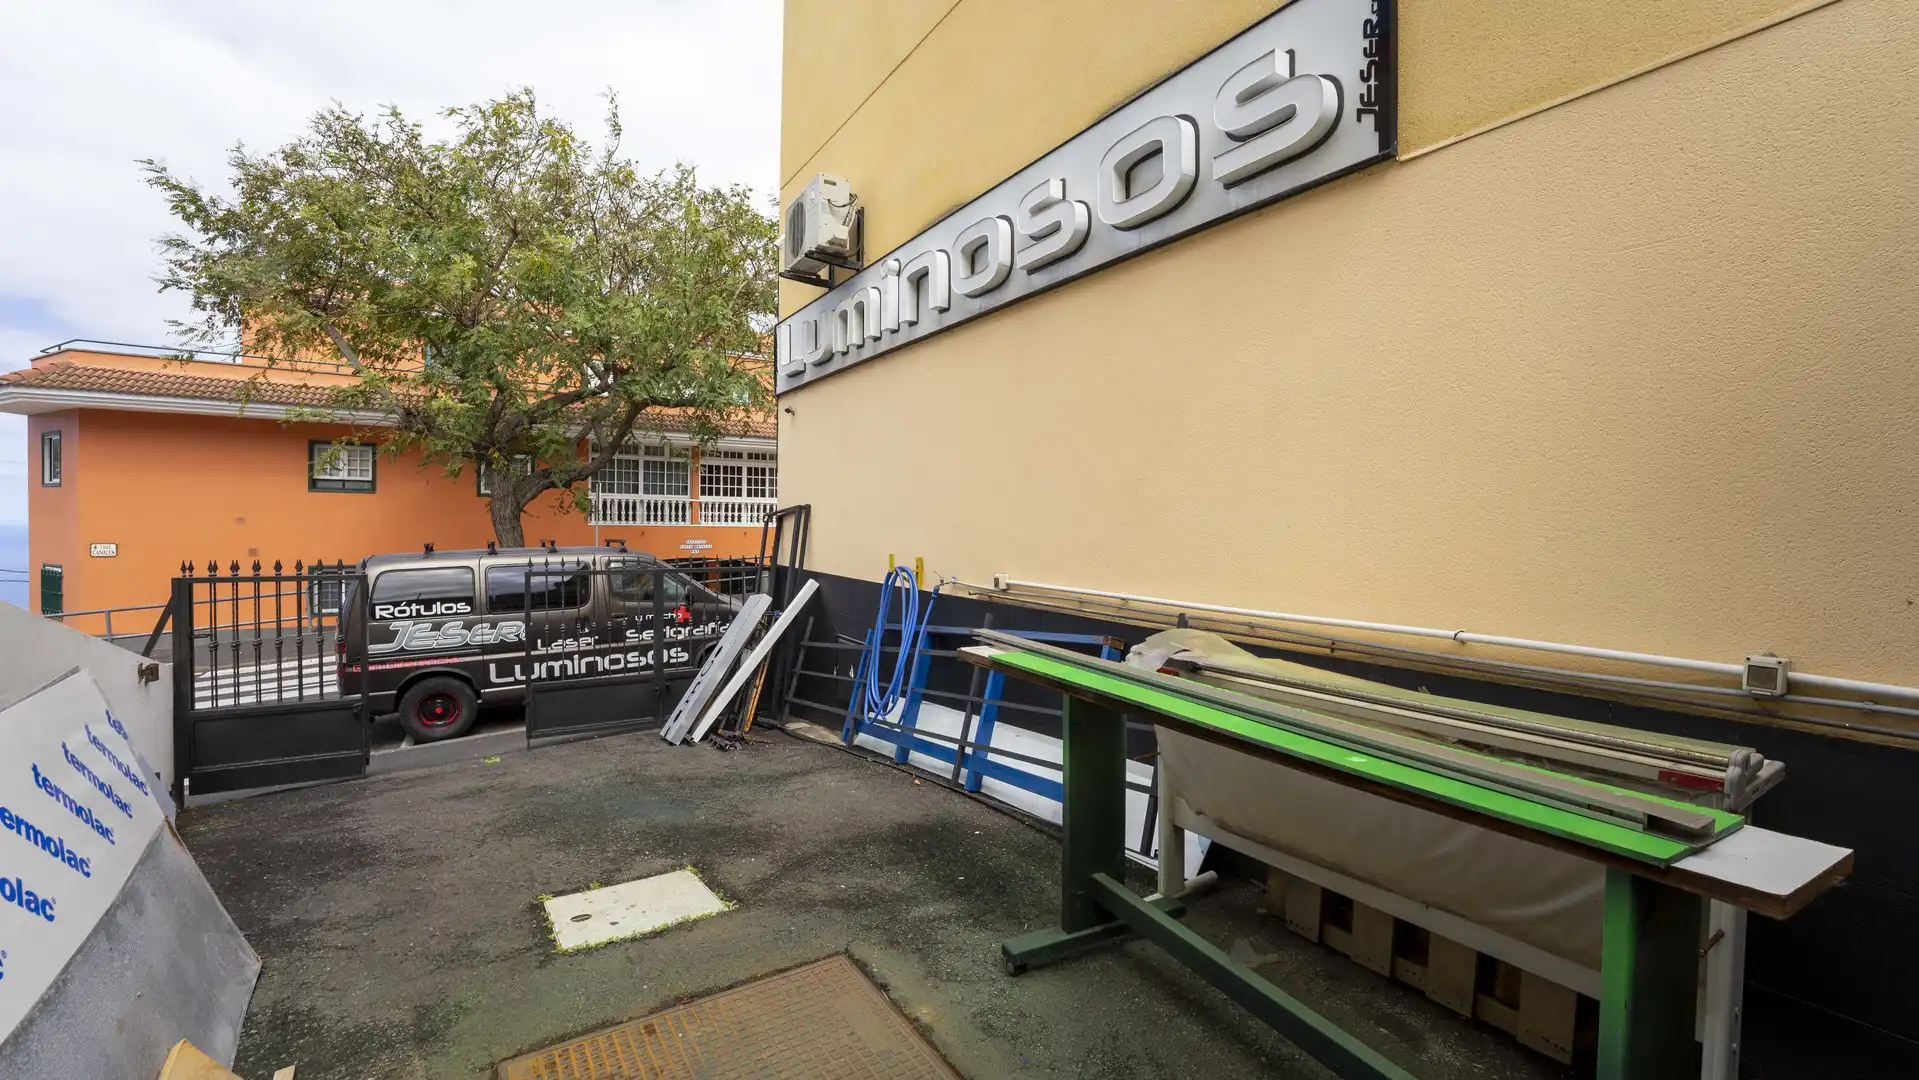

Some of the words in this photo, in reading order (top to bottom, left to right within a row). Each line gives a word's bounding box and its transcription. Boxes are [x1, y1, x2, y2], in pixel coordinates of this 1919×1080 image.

[375, 601, 472, 620] Rótulos
[62, 741, 133, 819] termolac
[85, 723, 149, 796] termolac
[31, 762, 115, 845] termolac
